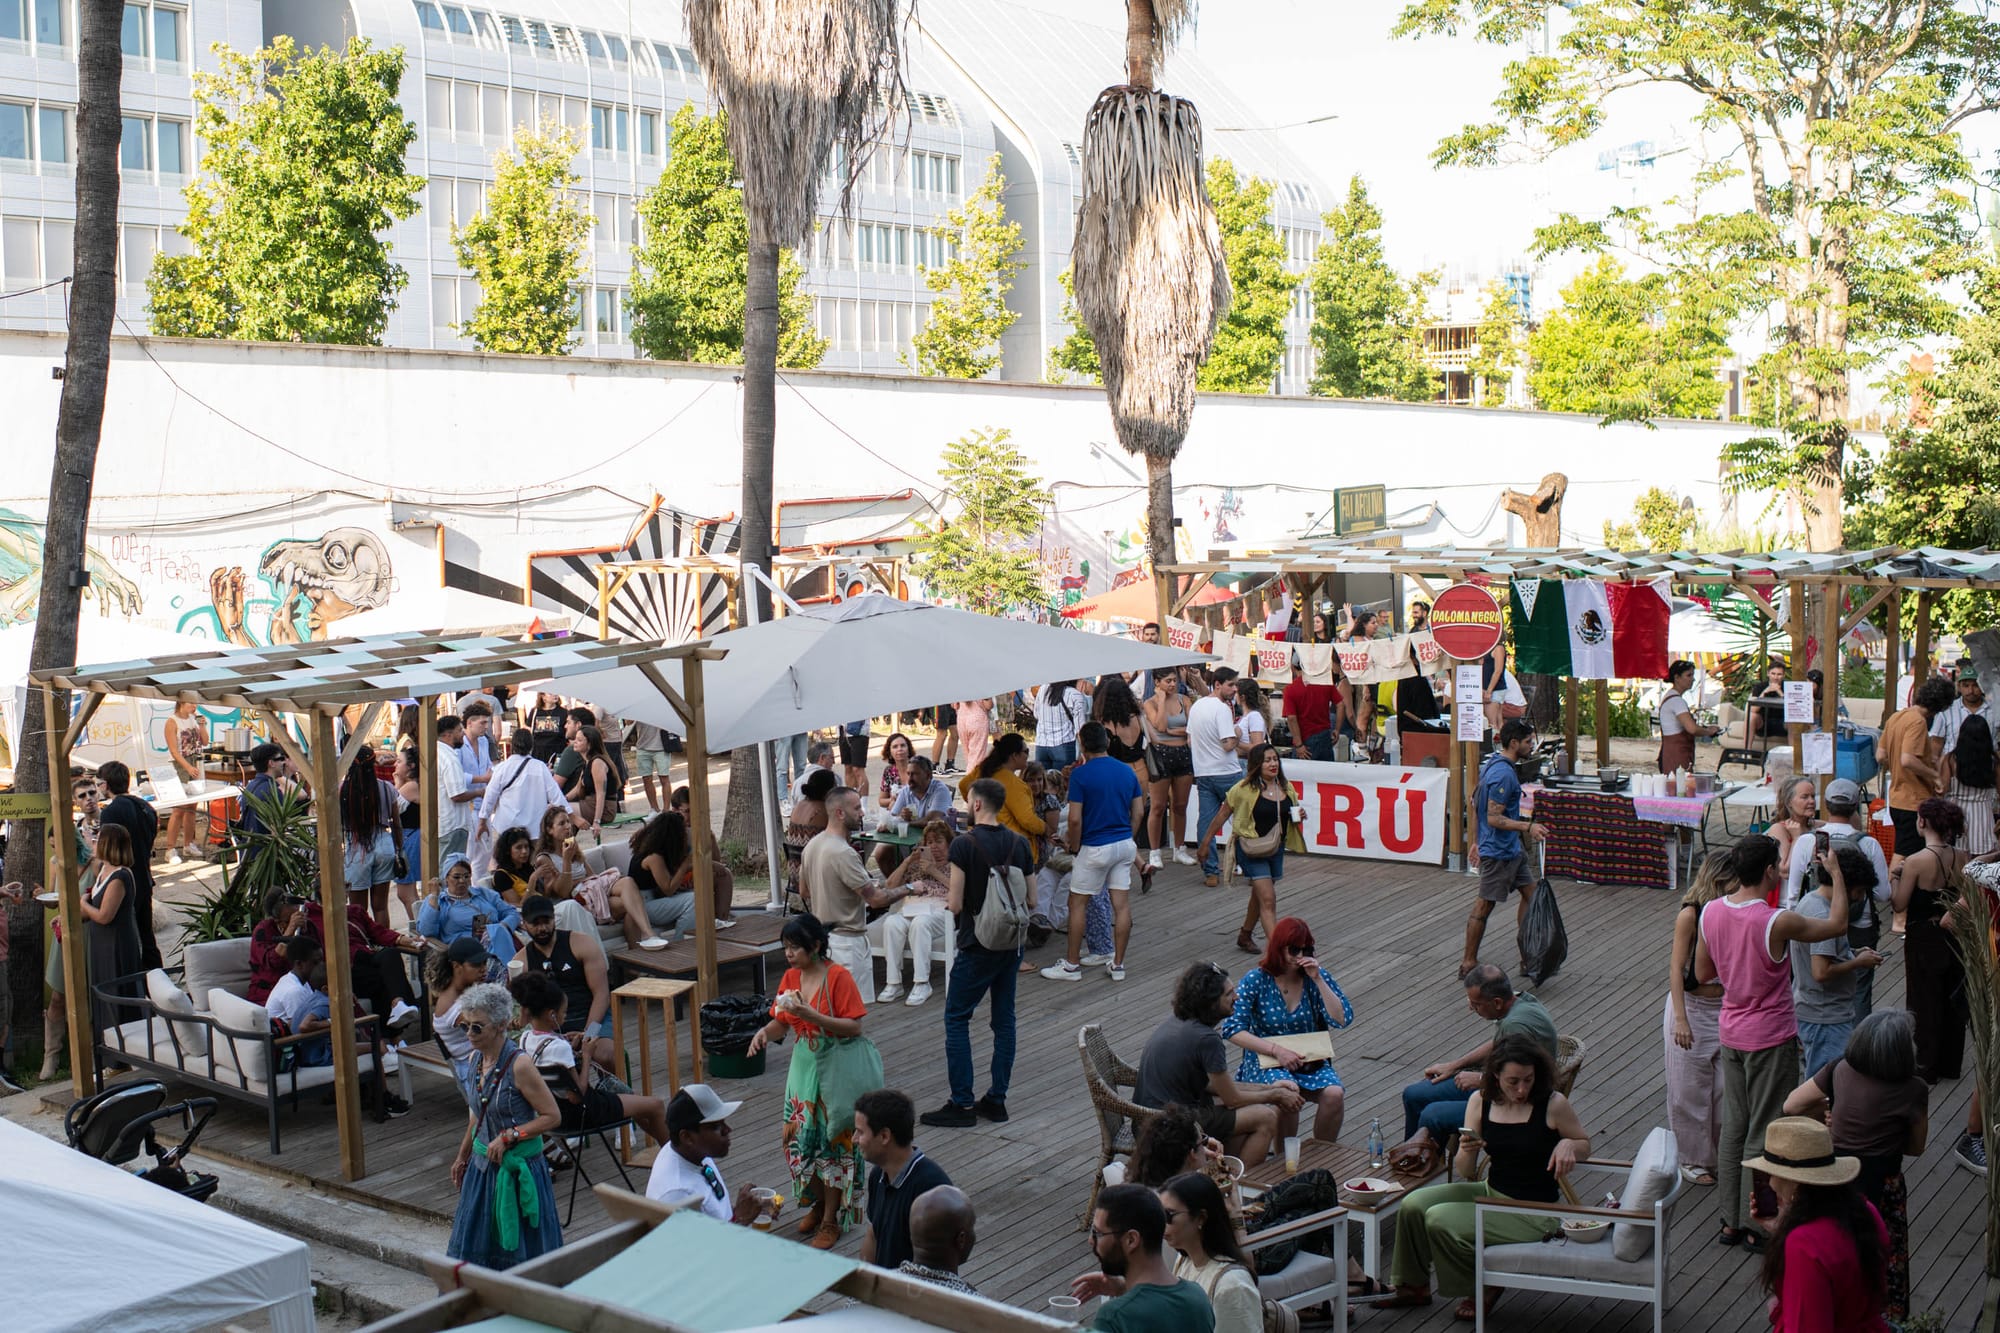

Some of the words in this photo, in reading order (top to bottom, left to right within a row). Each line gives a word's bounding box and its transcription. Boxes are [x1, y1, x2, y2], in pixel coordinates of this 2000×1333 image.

[1471, 610, 1500, 624] NEGRA
[1167, 626, 1194, 642] PISCO
[1169, 637, 1192, 650] OUR
[1258, 650, 1286, 661] PISCO
[1338, 652, 1369, 663] PISCO
[1261, 659, 1287, 669] OUR
[1342, 662, 1369, 671] OUR
